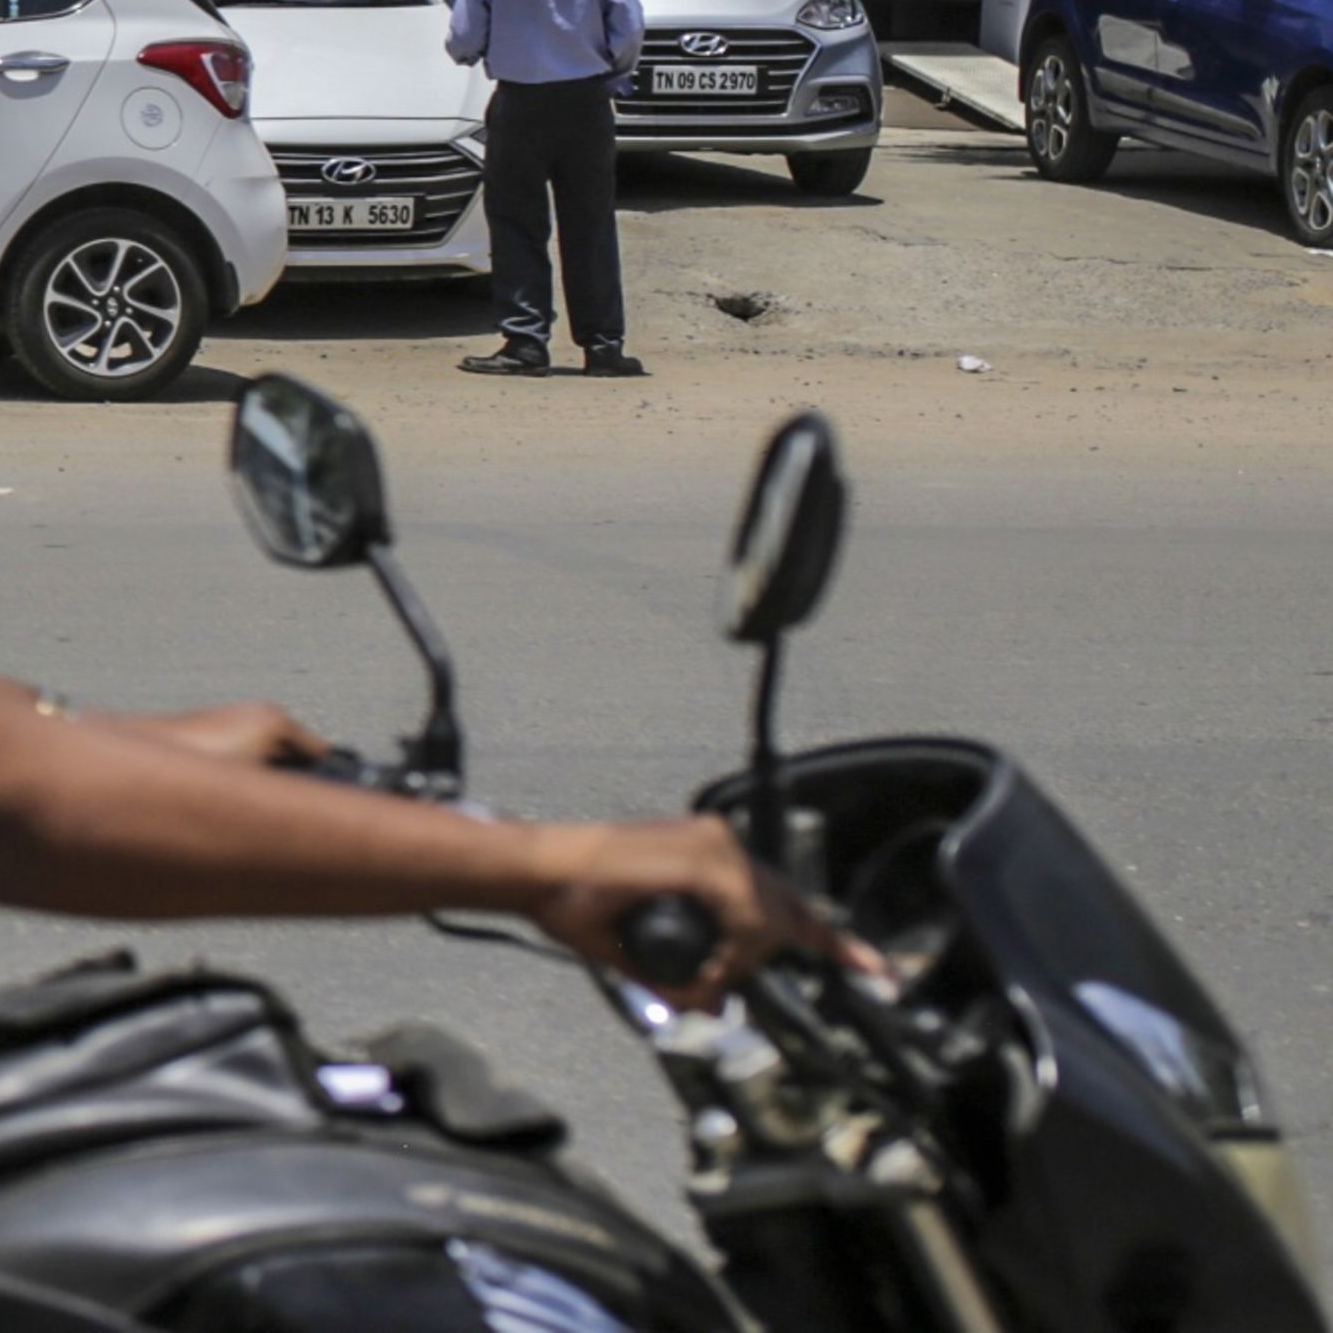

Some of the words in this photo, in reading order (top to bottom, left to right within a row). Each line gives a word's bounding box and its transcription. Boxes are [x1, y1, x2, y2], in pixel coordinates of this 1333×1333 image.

[655, 72, 674, 90] TN
[677, 72, 695, 90] 09
[698, 72, 717, 90] CS
[719, 72, 755, 90] 2970
[288, 205, 310, 225] TN
[315, 205, 334, 225] 13
[342, 205, 353, 225] K
[368, 205, 410, 225] 5630
